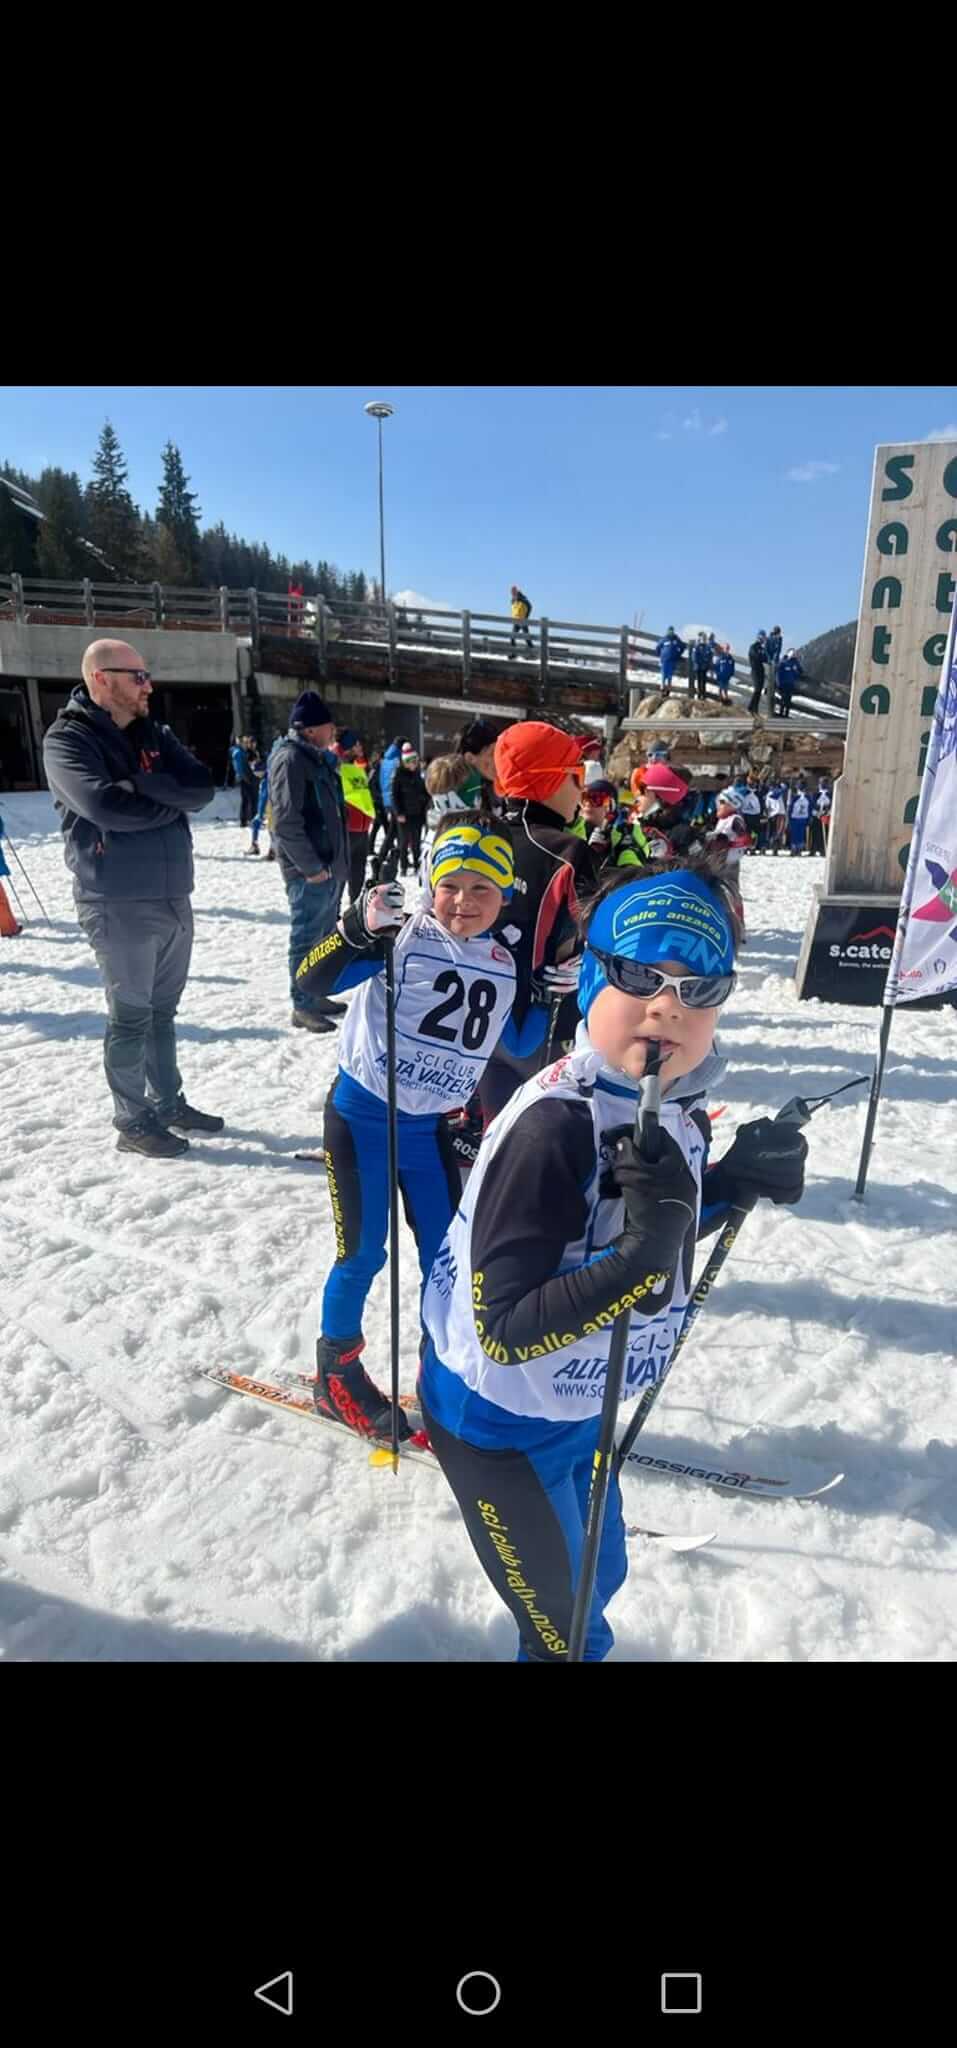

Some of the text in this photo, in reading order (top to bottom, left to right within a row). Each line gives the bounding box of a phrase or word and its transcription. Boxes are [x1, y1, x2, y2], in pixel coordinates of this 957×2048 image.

[859, 454, 915, 716] Santa
[647, 898, 712, 919] sci club
[623, 909, 721, 940] valle anzasca
[417, 969, 498, 1051] 28
[414, 1050, 477, 1079] SCI CLUB
[515, 1331, 577, 1362] valle
[477, 1499, 509, 1530] sci
[489, 1530, 523, 1568] club
